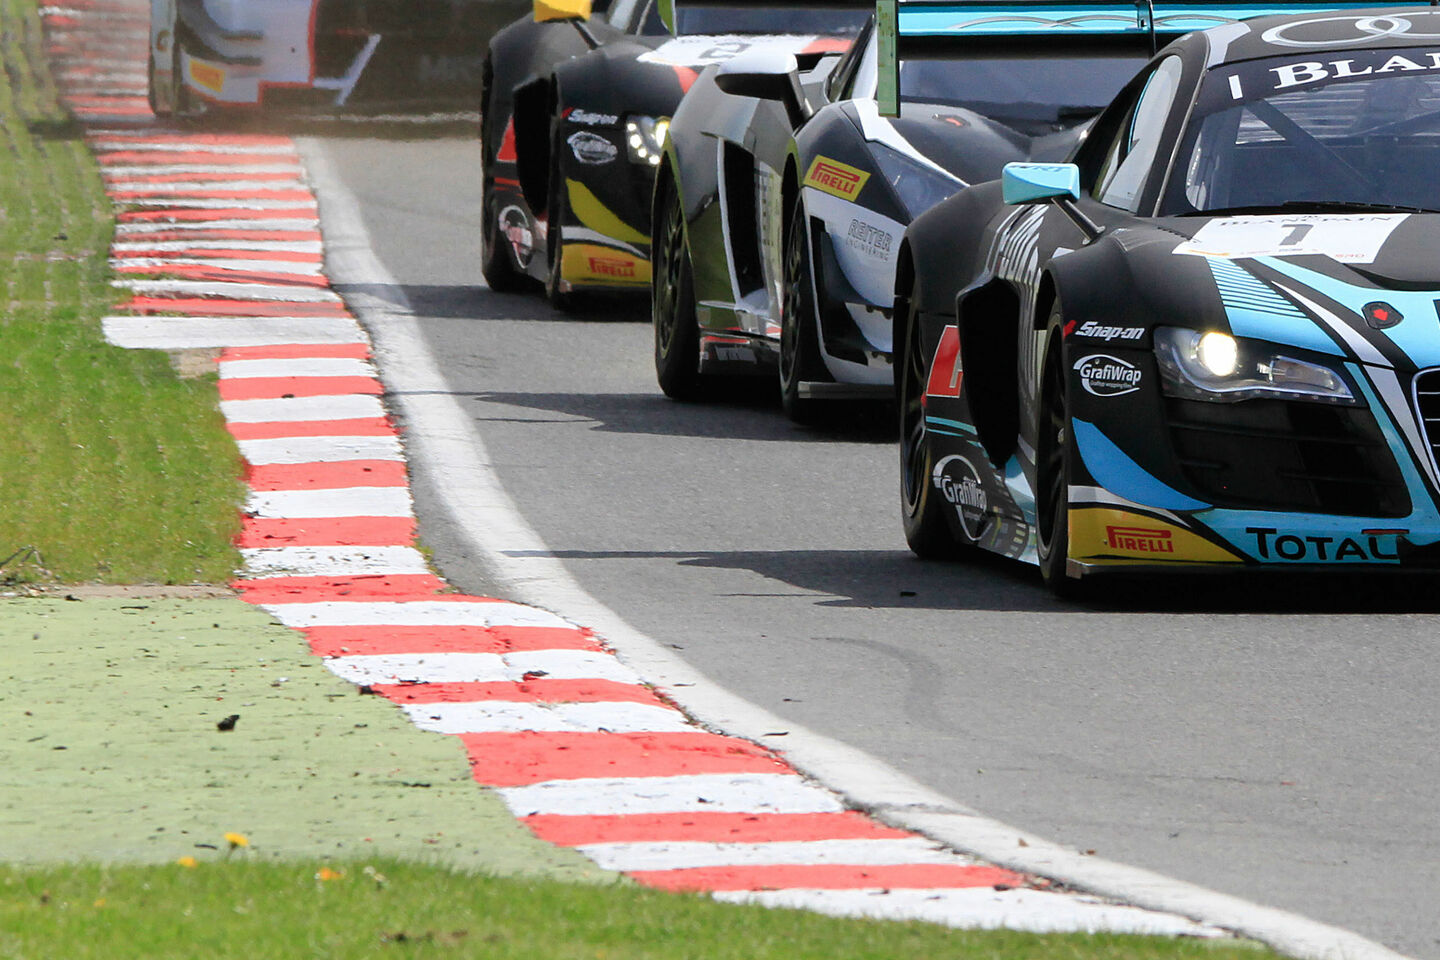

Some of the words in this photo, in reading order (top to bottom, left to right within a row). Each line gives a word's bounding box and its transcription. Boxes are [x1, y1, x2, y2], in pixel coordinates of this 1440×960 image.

[811, 162, 861, 195] PIRELLI
[848, 219, 893, 252] REITER
[1075, 321, 1145, 341] Snap-on
[1080, 363, 1142, 386] GrafiWrap
[1106, 525, 1175, 553] PIRELLI
